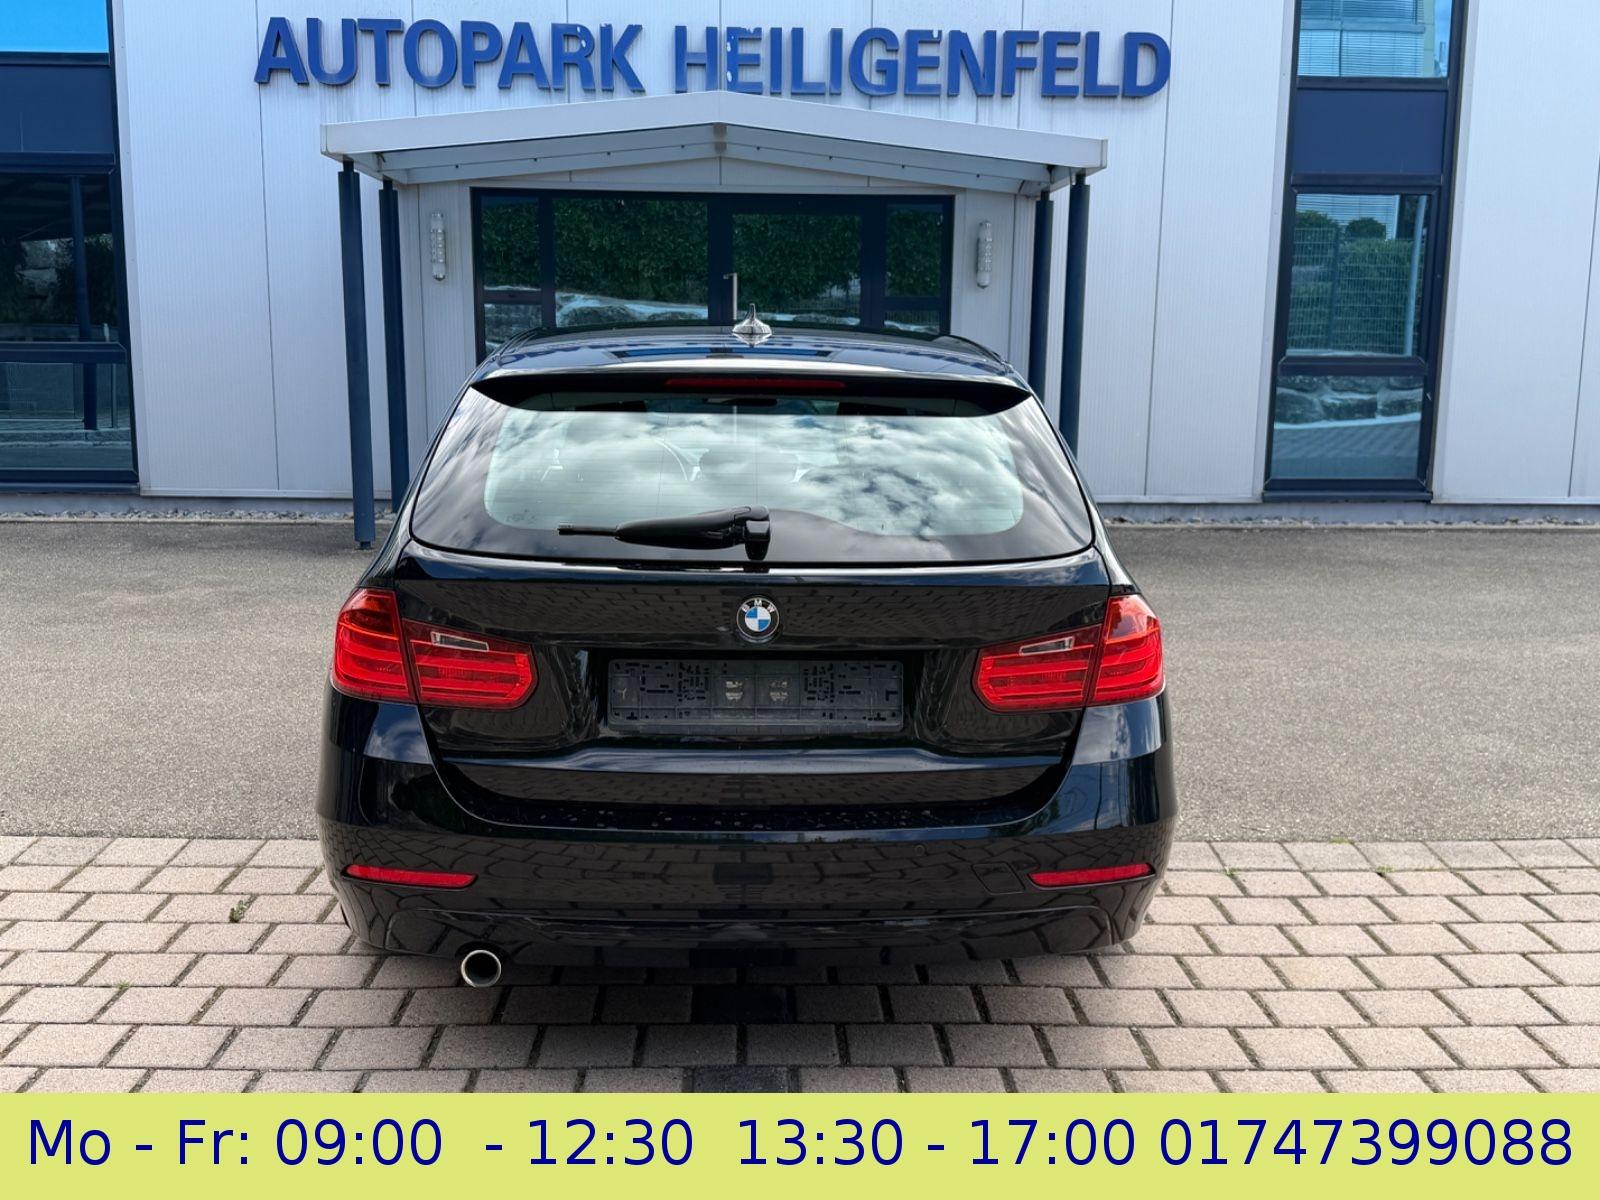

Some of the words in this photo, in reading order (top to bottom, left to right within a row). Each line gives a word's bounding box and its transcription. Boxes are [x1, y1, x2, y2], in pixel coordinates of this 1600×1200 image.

[254, 17, 645, 93] AUTOPARK
[674, 26, 1171, 98] HEILIGENFELD
[741, 598, 776, 613] BMW
